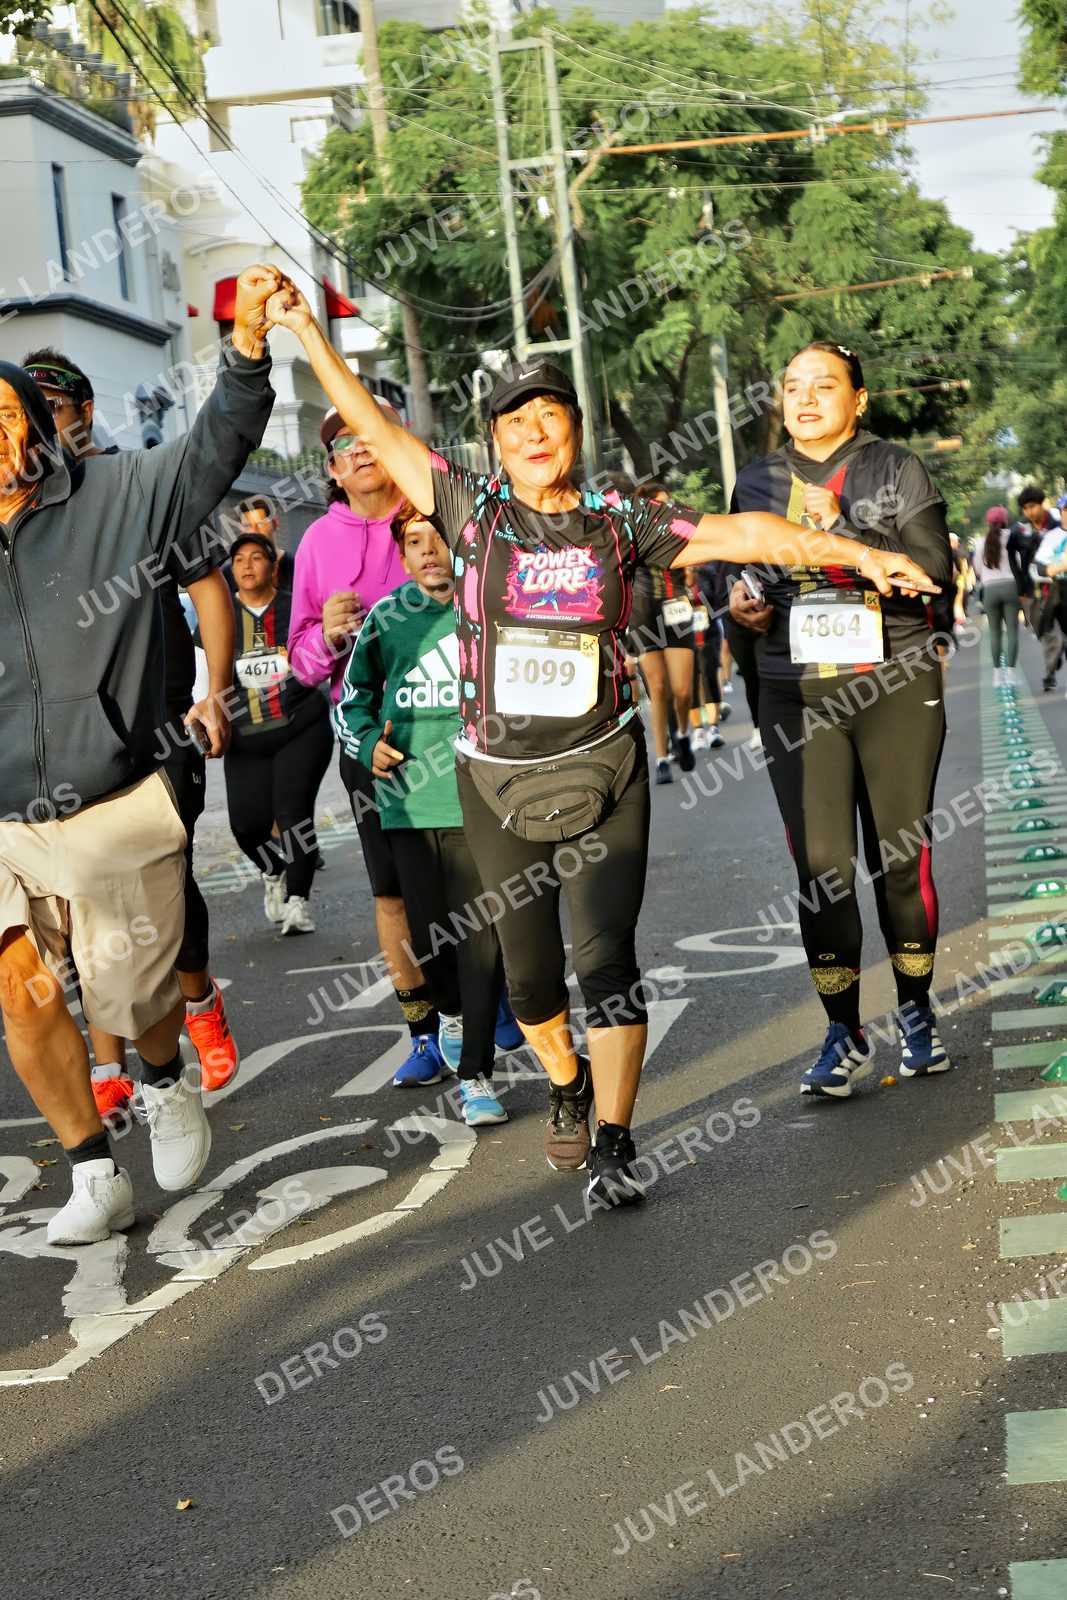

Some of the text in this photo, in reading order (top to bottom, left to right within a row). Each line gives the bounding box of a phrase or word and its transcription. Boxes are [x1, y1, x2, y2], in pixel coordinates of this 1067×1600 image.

[518, 549, 596, 571] POWER
[522, 565, 590, 591] LORE
[801, 613, 862, 637] 4864
[582, 641, 596, 651] 5K
[245, 660, 278, 676] 4671
[506, 656, 576, 687] 3099
[395, 679, 460, 708] adid
